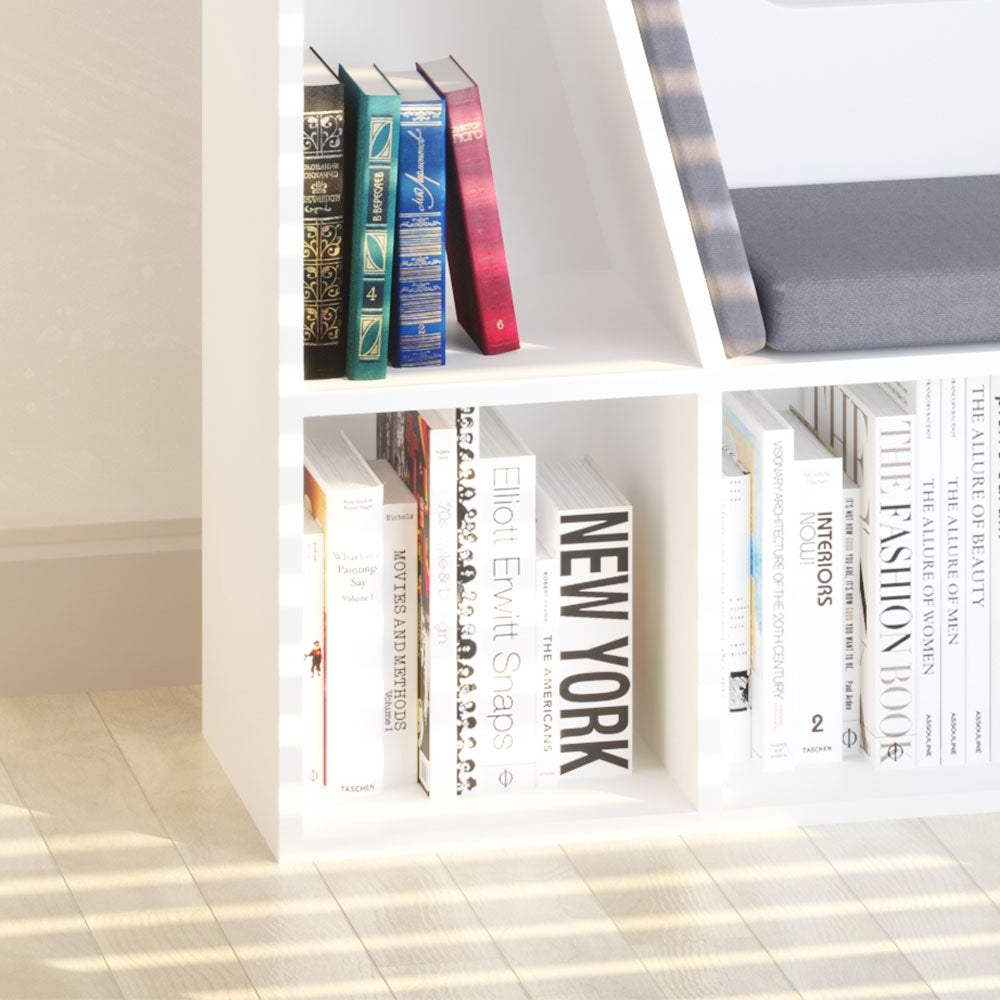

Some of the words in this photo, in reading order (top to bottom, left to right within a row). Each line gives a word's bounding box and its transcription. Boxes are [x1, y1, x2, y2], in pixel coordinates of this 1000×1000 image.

[366, 287, 377, 301] 4
[418, 323, 426, 335] 2
[496, 319, 504, 330] 6
[971, 385, 985, 425] THE
[773, 440, 784, 491] VISIONARY
[879, 420, 912, 494] THE
[971, 429, 985, 500] ALLURE
[493, 466, 521, 544] Elliott
[922, 478, 935, 513] THE
[947, 477, 959, 510] THE
[799, 511, 816, 566] NOW!
[971, 504, 985, 529] OF
[559, 510, 629, 621] NEW
[817, 511, 833, 607] INTERIORS
[922, 516, 935, 581] ALLURE
[947, 515, 959, 579] ALLURE
[351, 578, 366, 588] Say
[394, 549, 407, 617] MOVIES
[773, 573, 784, 586] OF
[879, 503, 912, 653] FASHION
[971, 534, 985, 608] BEAUTY
[493, 557, 521, 640] Erwitt
[773, 589, 784, 611] THE
[922, 584, 935, 607] OF
[947, 583, 959, 605] OF
[394, 618, 407, 652] AND
[542, 635, 553, 662] THE
[773, 613, 784, 644] 20TH
[922, 610, 935, 676] WOMEN
[947, 609, 959, 645] MEN
[394, 653, 407, 732] METHODS
[773, 645, 784, 699] CENTURY
[486, 652, 521, 751] Snaps
[542, 668, 553, 753] AMERICANS
[559, 636, 631, 776] YORK
[811, 713, 825, 733] 2
[879, 665, 912, 763] BOOK
[803, 745, 832, 753] TASCHEN
[925, 713, 933, 758] ASSOULINE
[950, 712, 958, 756] ASSOULINE
[975, 710, 983, 754] ASSOULINE
[341, 784, 375, 793] TASCHEN
